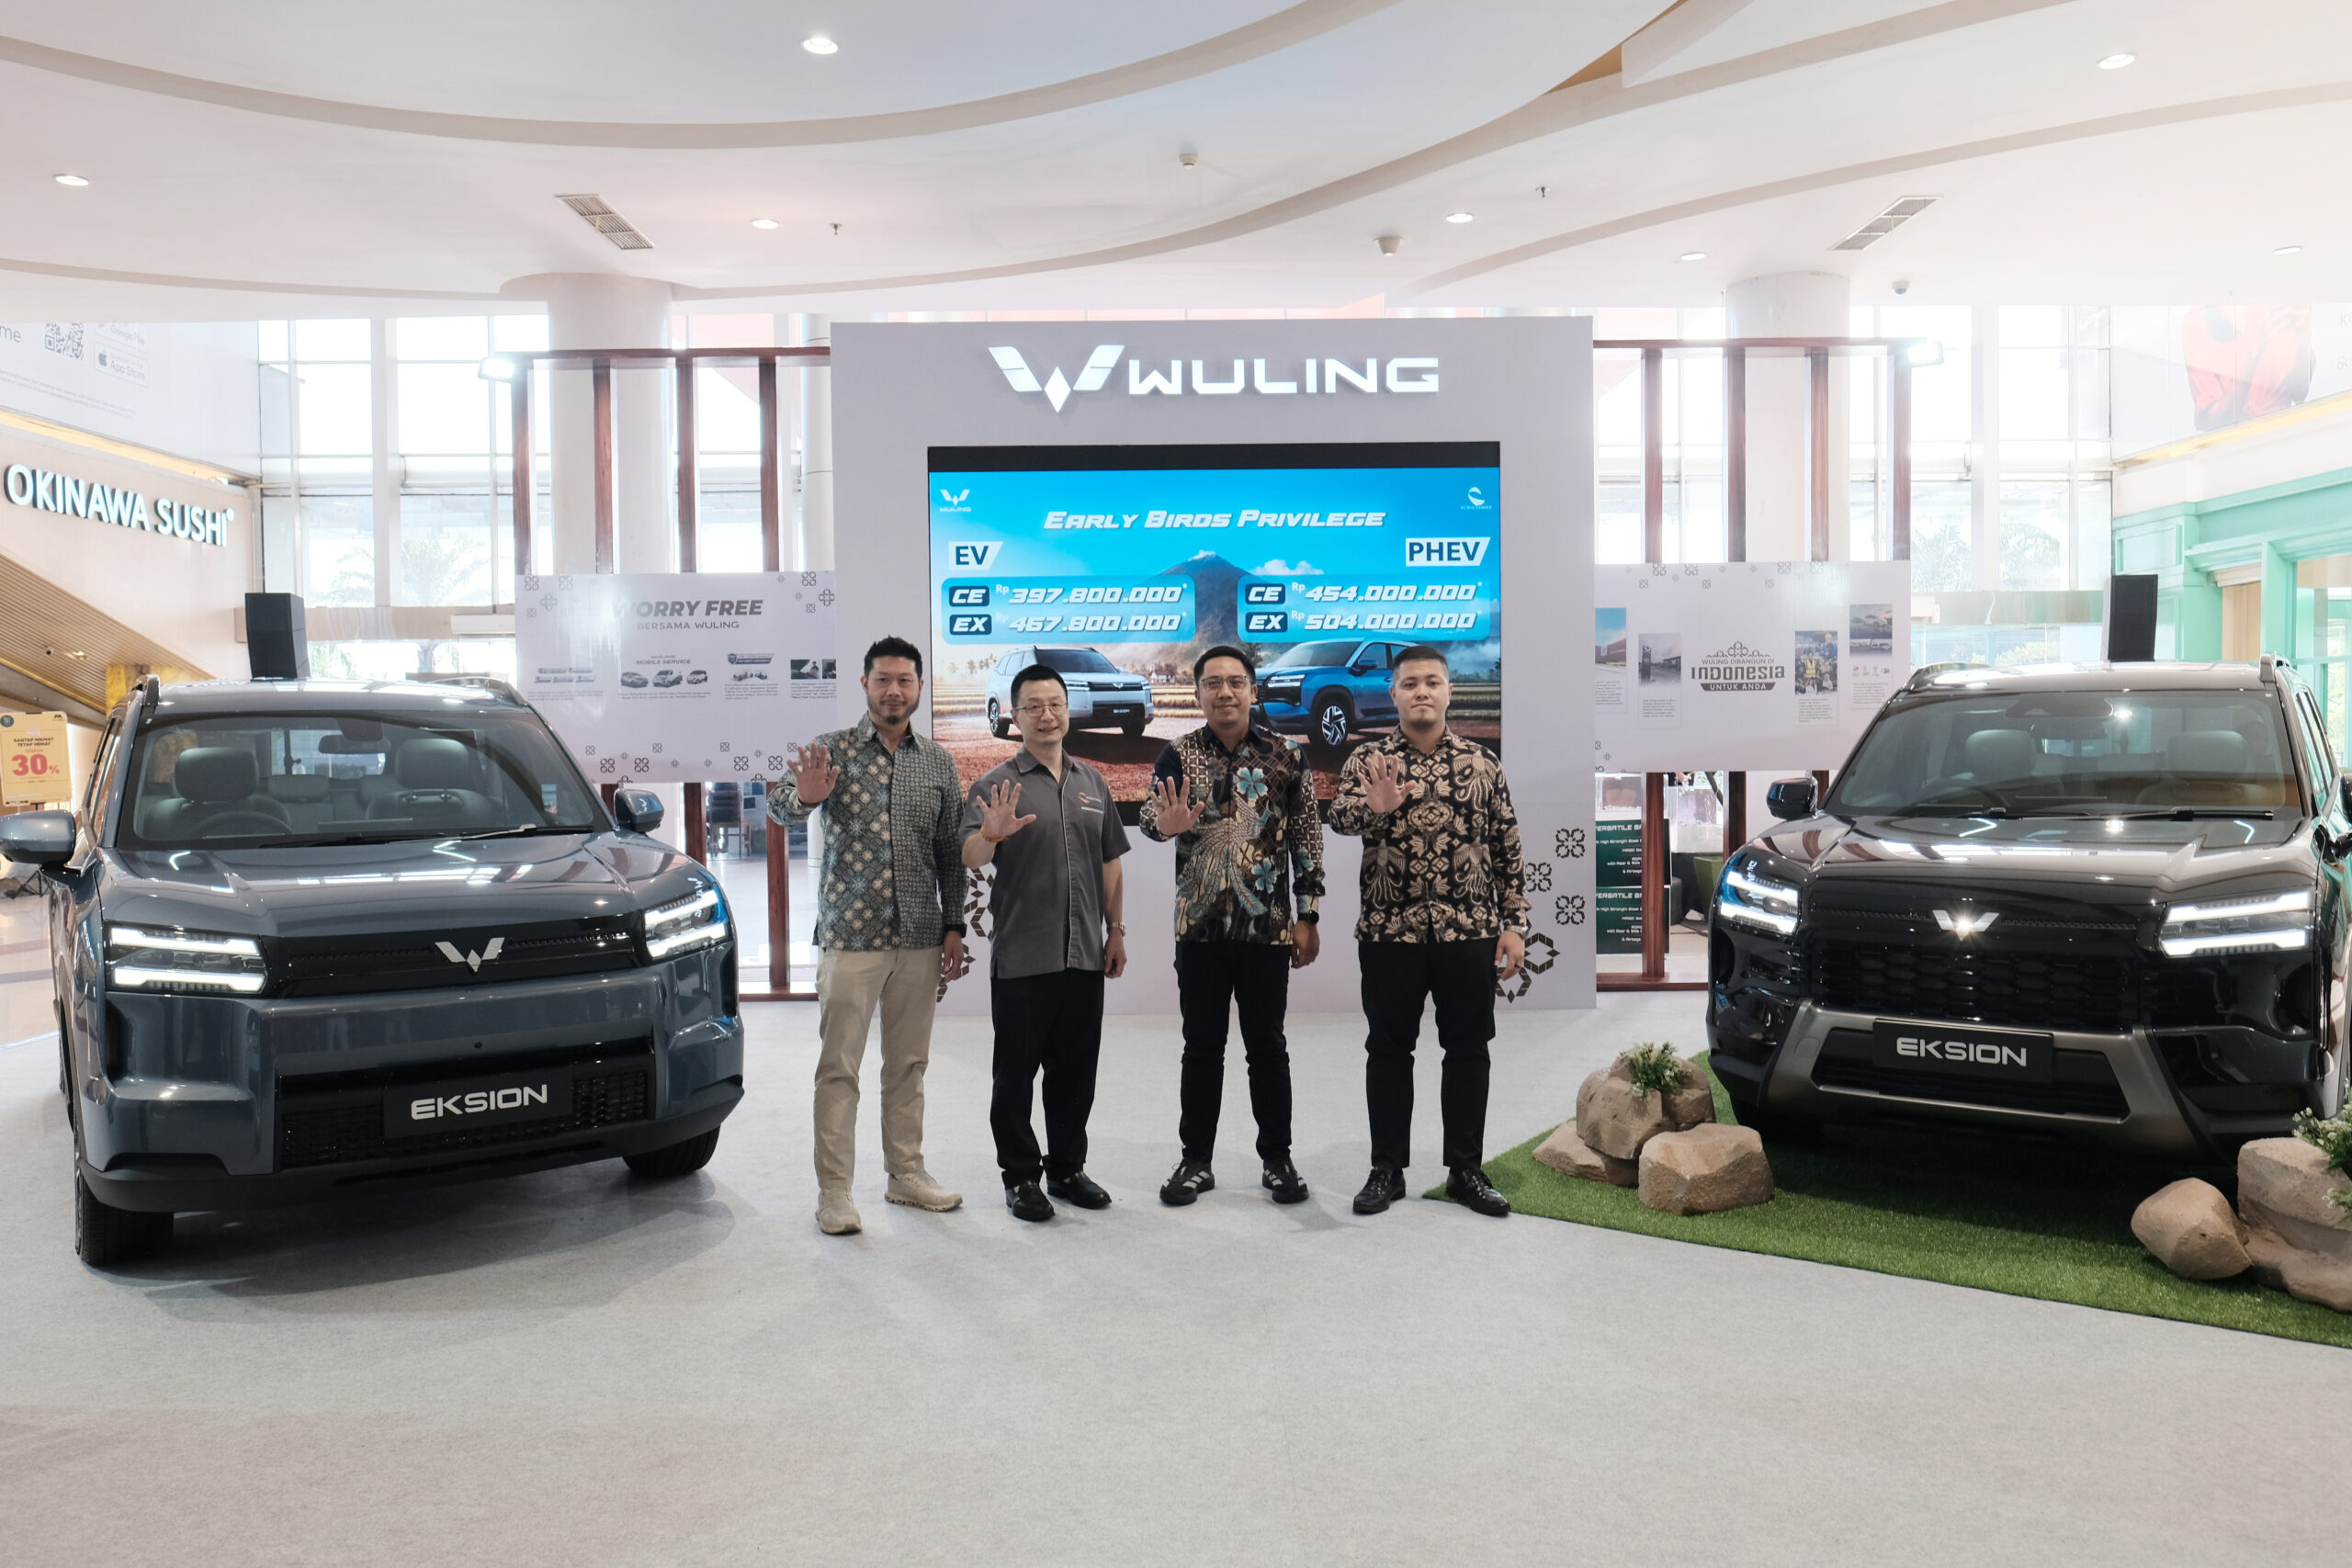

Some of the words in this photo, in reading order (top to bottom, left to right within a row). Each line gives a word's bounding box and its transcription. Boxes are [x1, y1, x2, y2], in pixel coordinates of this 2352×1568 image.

[110, 359, 125, 375] App
[126, 366, 146, 381] Store
[1129, 356, 1439, 395] WULING
[5, 463, 151, 532] OKINAWA
[154, 497, 229, 547] SUSHI
[1044, 511, 1139, 530] EARLY
[1144, 510, 1232, 529] BIRDS
[1237, 510, 1386, 528] PRIVILEGE
[956, 546, 989, 566] EV
[1408, 541, 1480, 561] PHEV
[952, 589, 986, 604] CE
[995, 584, 1010, 595] Rp
[1248, 586, 1283, 602] CE
[1292, 582, 1306, 593] Rp
[705, 600, 763, 616] FREE
[638, 622, 691, 631] BERSAMA
[695, 621, 740, 629] WULING
[952, 616, 989, 632] EX
[1249, 615, 1284, 629] EX
[1292, 610, 1305, 621] Rp
[11, 753, 60, 776] 30%
[1896, 1037, 2027, 1067] EKSION
[411, 1084, 548, 1120] EKSION
